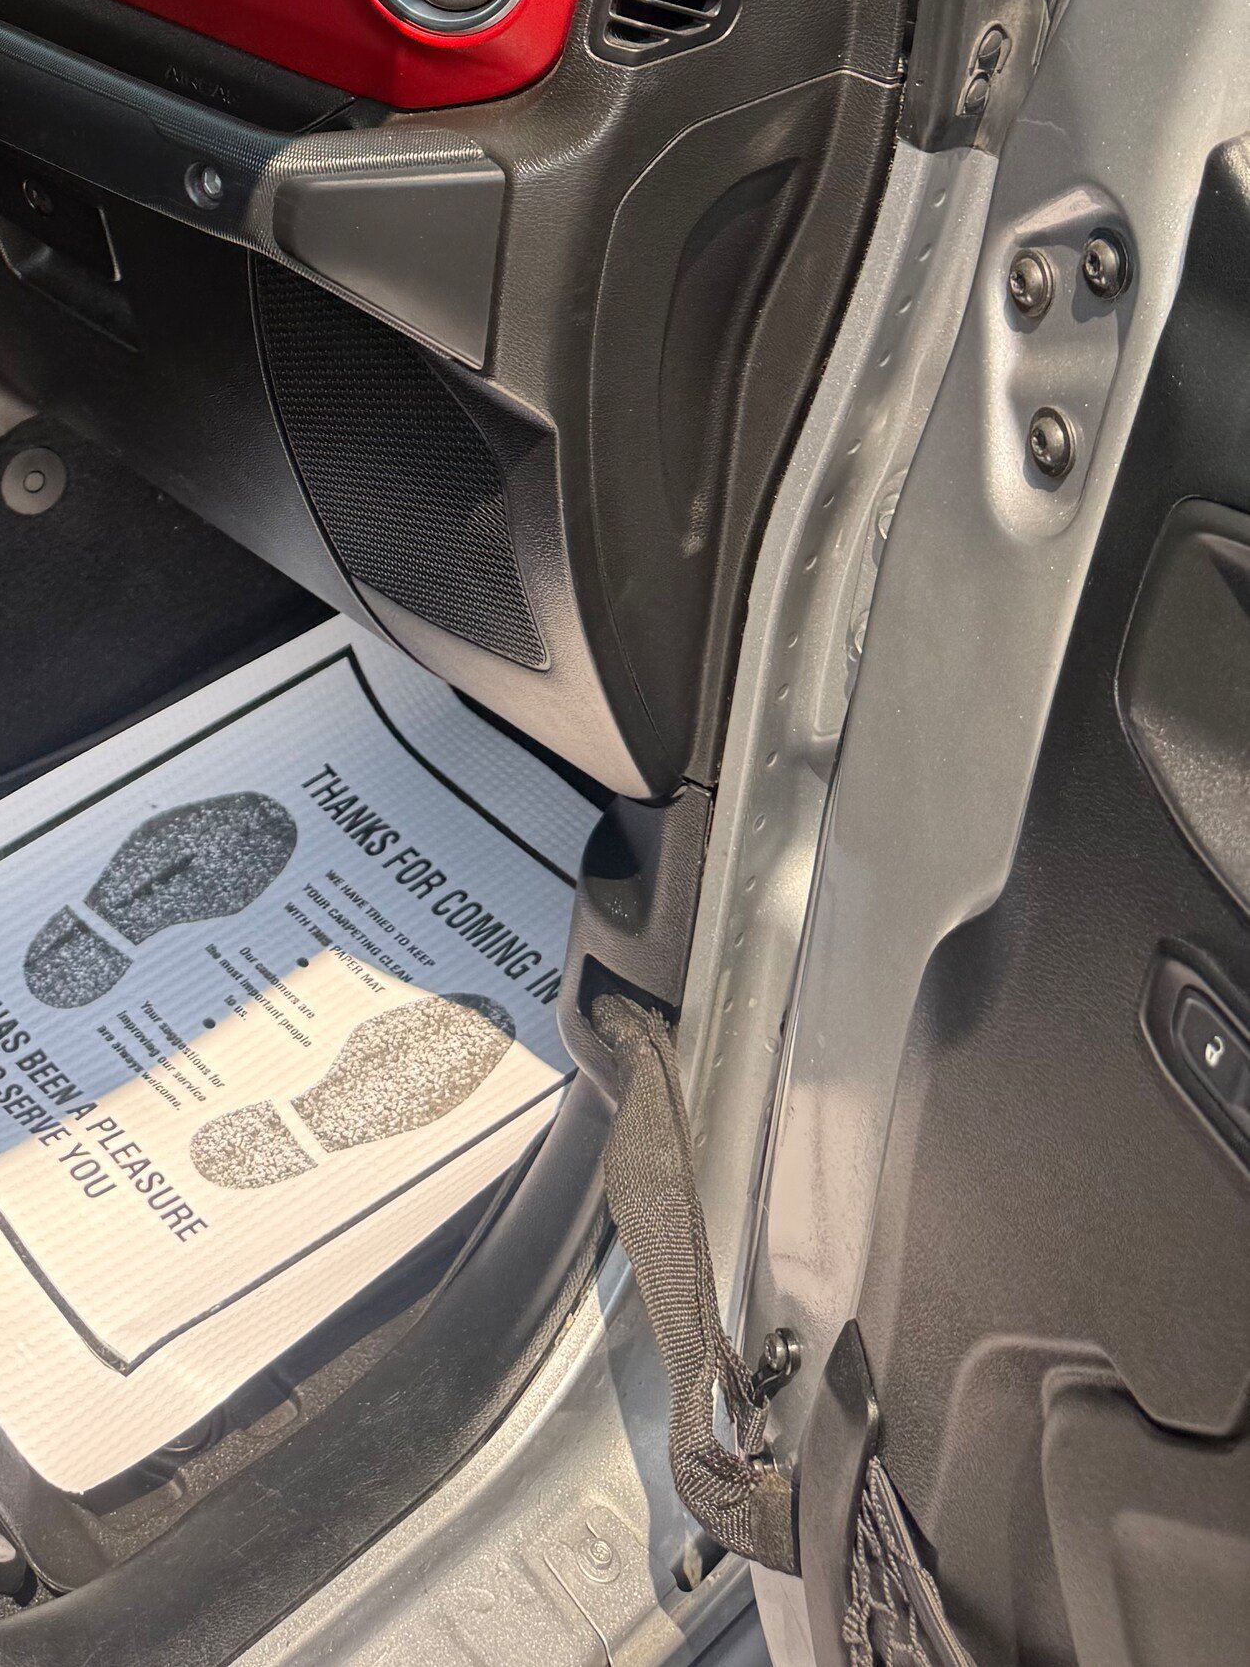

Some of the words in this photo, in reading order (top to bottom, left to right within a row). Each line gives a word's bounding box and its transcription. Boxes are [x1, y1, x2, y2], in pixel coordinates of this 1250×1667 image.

[301, 763, 400, 856] THANKS
[382, 846, 447, 899] FOR
[431, 888, 542, 980] COMING
[283, 901, 310, 927] WITH
[307, 924, 334, 947] THIS
[329, 945, 367, 977] PAPER
[360, 973, 386, 994] MAT
[301, 882, 330, 910] YOUR
[327, 906, 382, 957] CARPETING
[378, 954, 414, 983] CLEAN
[324, 868, 343, 888] WE
[340, 883, 368, 909] HAVE
[365, 903, 395, 934] TRIED
[393, 931, 409, 947] TO
[406, 941, 436, 967] KEEP
[219, 958, 244, 981] most
[279, 1013, 312, 1048] people
[238, 946, 259, 964] Our
[297, 1002, 316, 1020] are
[96, 1024, 115, 1042] are
[140, 999, 163, 1023] Your
[208, 1074, 225, 1088] for
[157, 1056, 176, 1072] our
[172, 1071, 207, 1102] service
[15, 1048, 84, 1106] BEEN
[65, 1102, 98, 1121] A
[86, 1116, 209, 1242] PLEASURE
[58, 1142, 117, 1199] YOU
